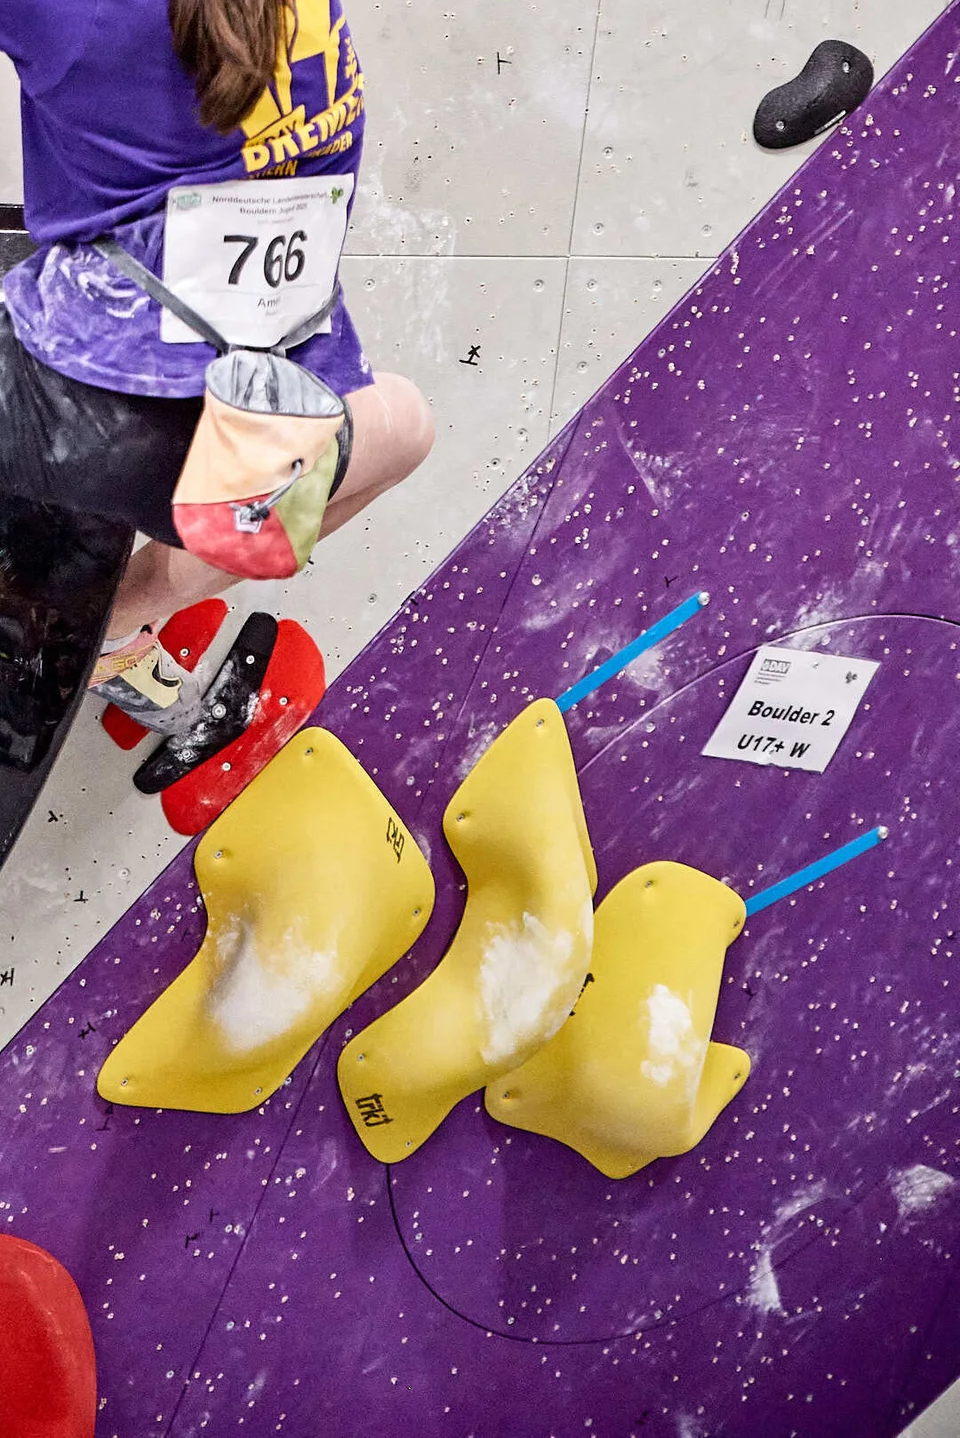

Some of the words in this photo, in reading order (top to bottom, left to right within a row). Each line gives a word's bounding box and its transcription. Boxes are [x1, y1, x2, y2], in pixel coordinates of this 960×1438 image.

[223, 230, 308, 288] 766
[747, 700, 819, 725] Boulder
[820, 709, 836, 727] 2
[737, 734, 785, 754] U17+
[790, 742, 811, 758] W
